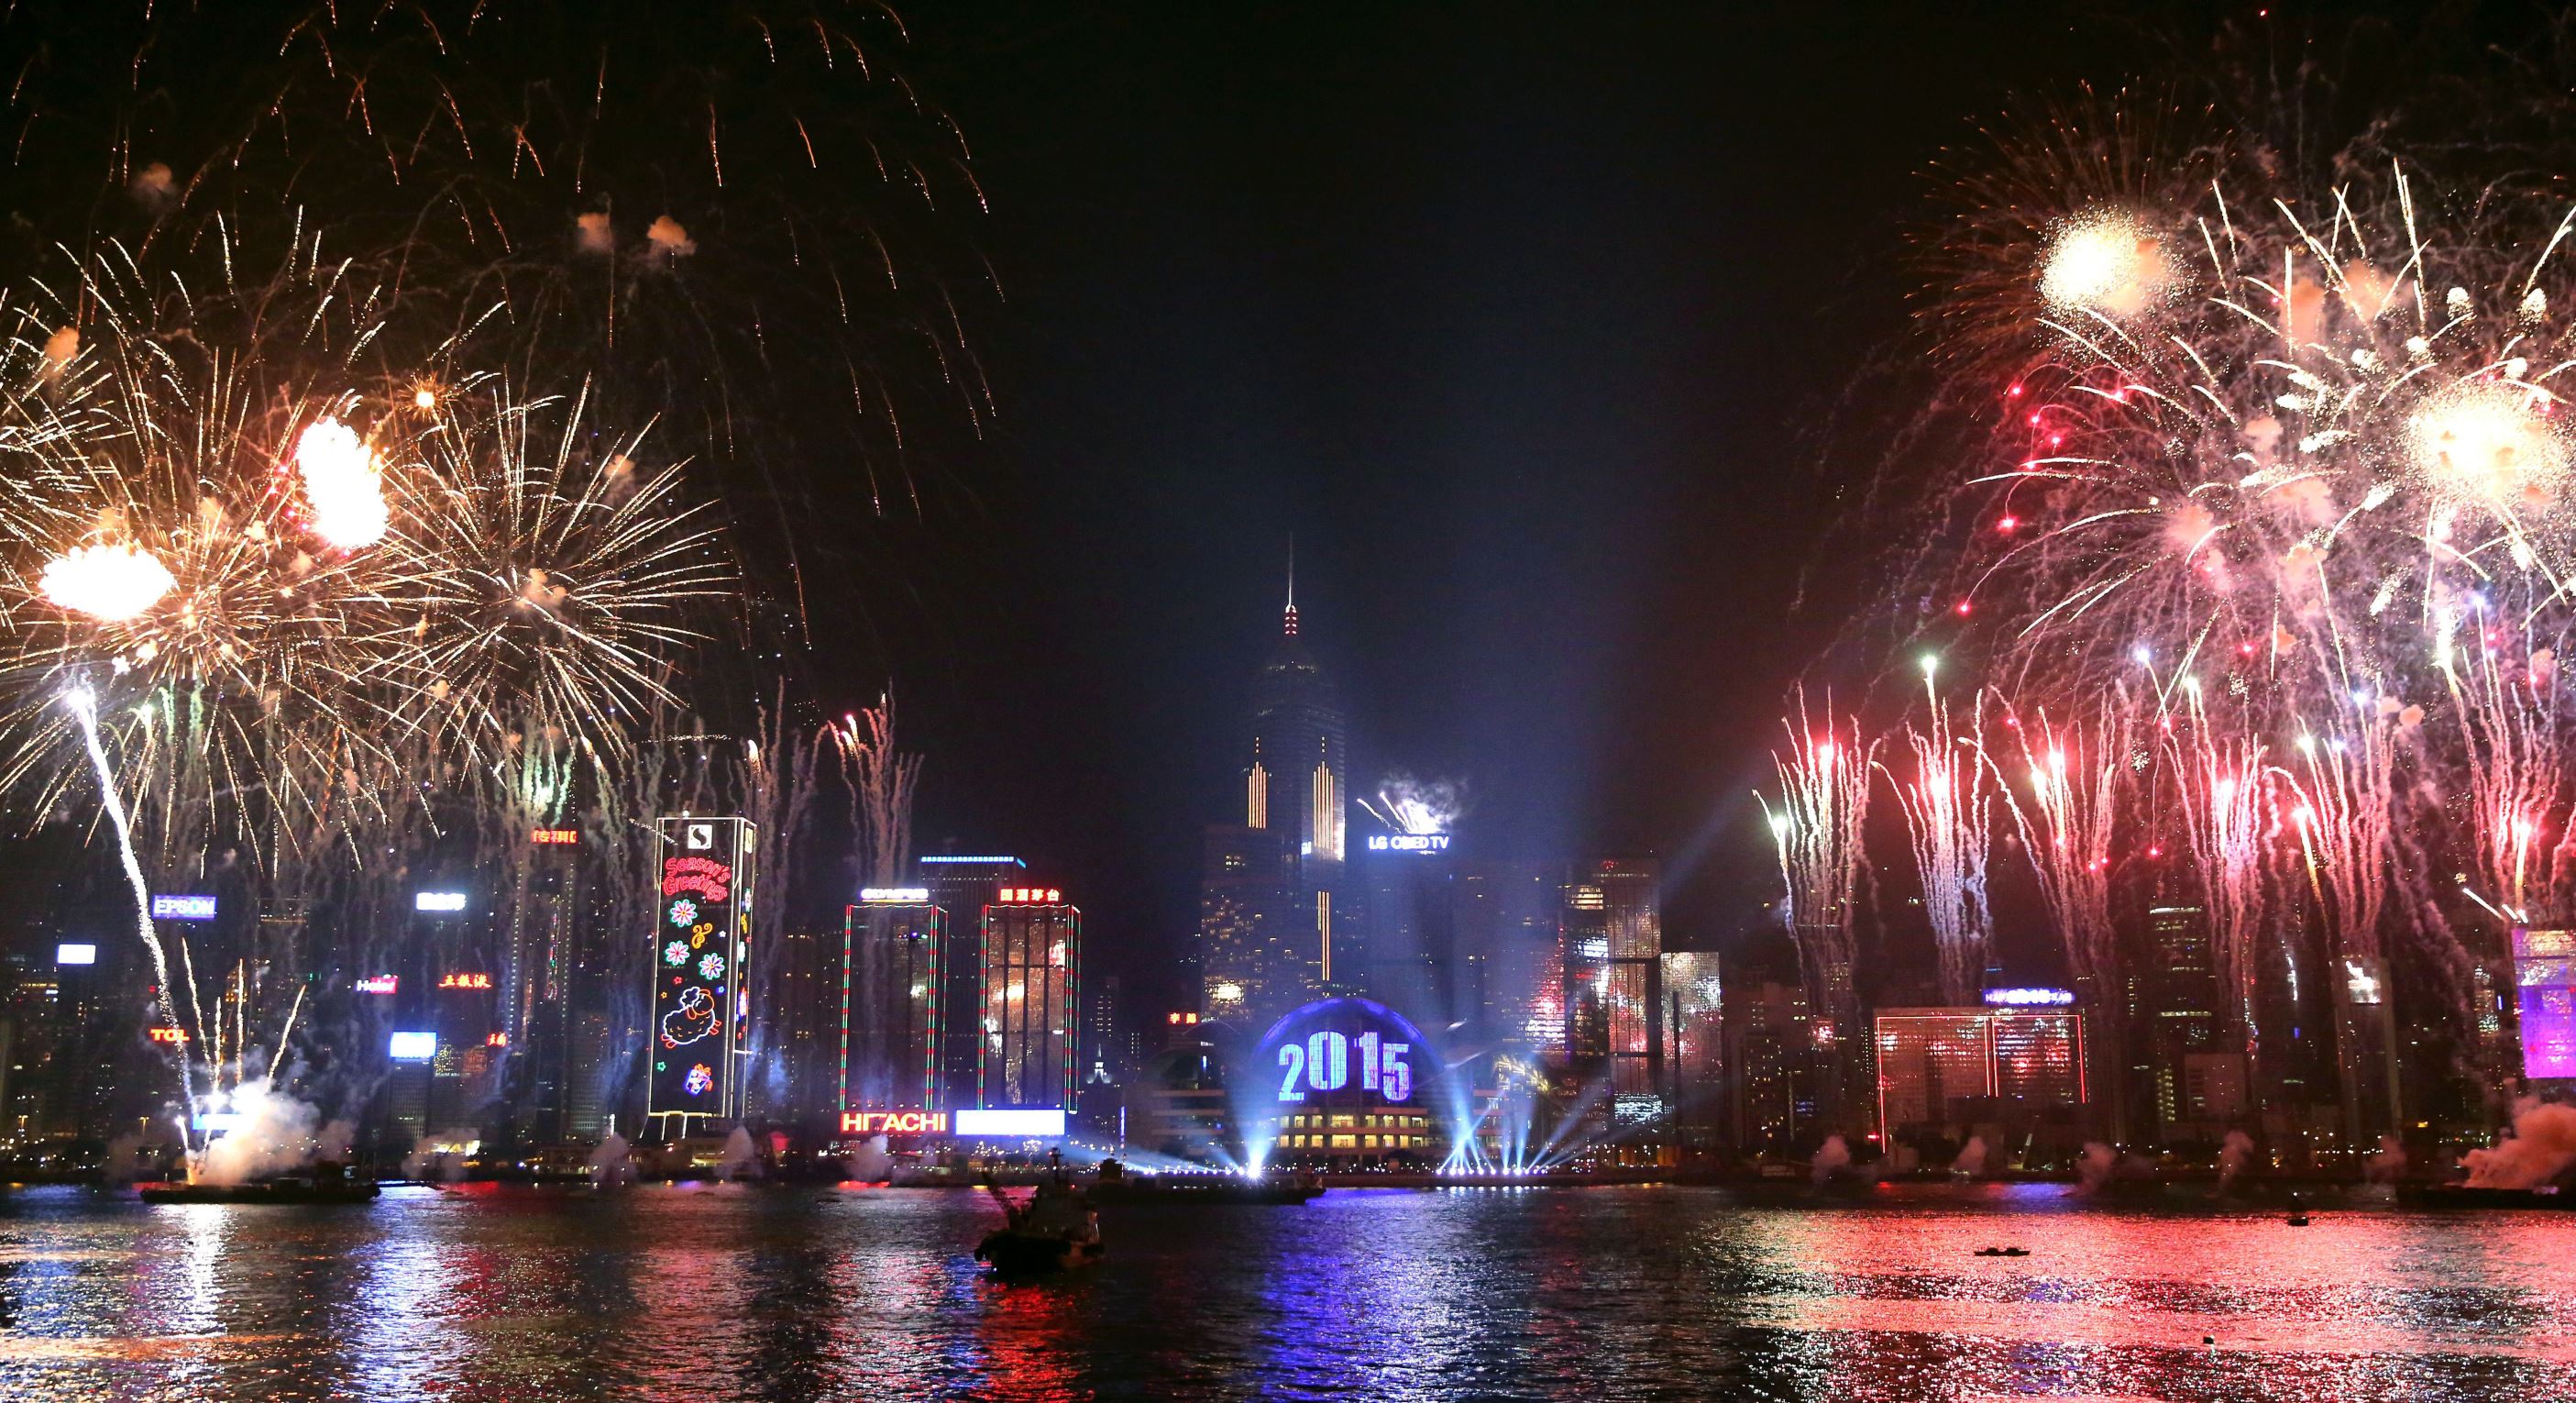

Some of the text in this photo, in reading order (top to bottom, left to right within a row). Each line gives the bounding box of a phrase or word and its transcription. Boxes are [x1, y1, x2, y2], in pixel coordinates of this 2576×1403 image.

[1369, 835, 1388, 850] LG
[1430, 835, 1449, 849] TV
[665, 857, 731, 883] Season's
[662, 875, 728, 900] Greetings
[153, 899, 215, 915] EPSON
[150, 1028, 191, 1042] TCL
[1278, 1031, 1410, 1101] 2015
